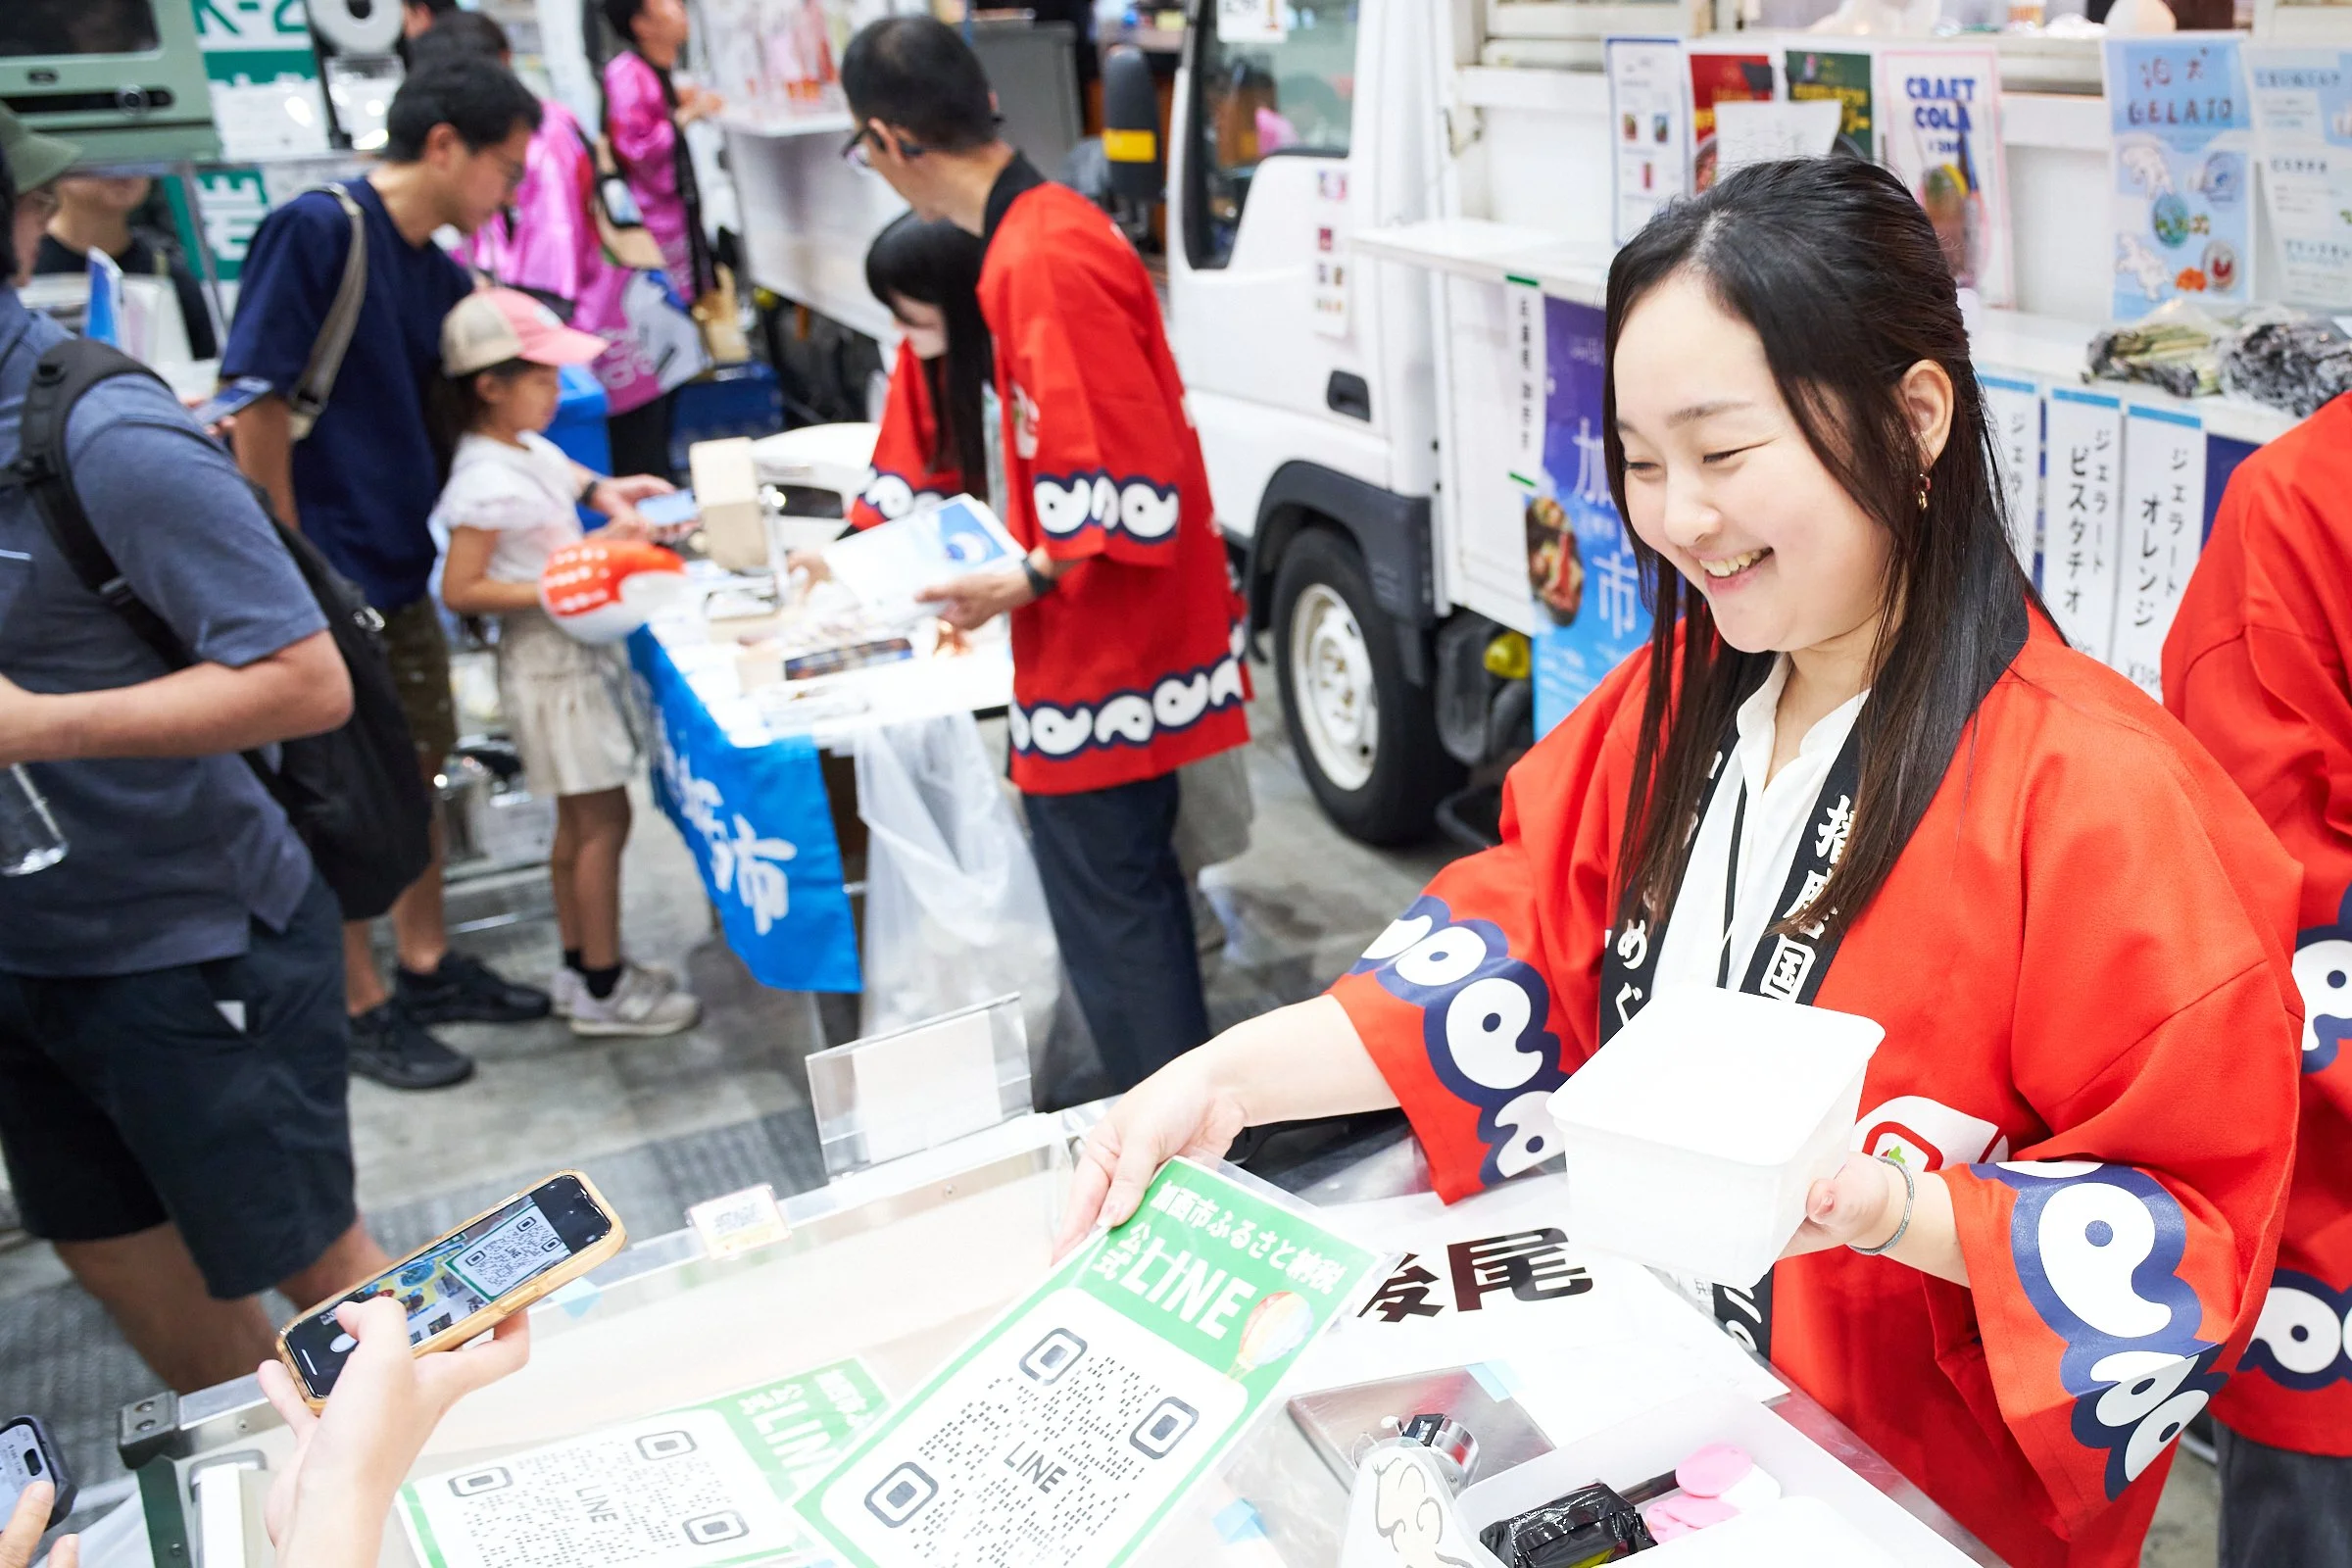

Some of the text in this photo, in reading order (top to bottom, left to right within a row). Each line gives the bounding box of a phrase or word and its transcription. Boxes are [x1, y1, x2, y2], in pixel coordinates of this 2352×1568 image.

[1906, 76, 1976, 100] CRAFT
[2128, 98, 2233, 125] GELATO
[1914, 107, 1971, 130] COLA
[2094, 428, 2111, 574] ジェラート
[2165, 448, 2186, 597] ジェラート
[2133, 492, 2162, 627] オレンジ
[1092, 1222, 1257, 1340] 公式 LINE
[1003, 1441, 1068, 1494] LINE
[575, 1485, 619, 1523] LINE
